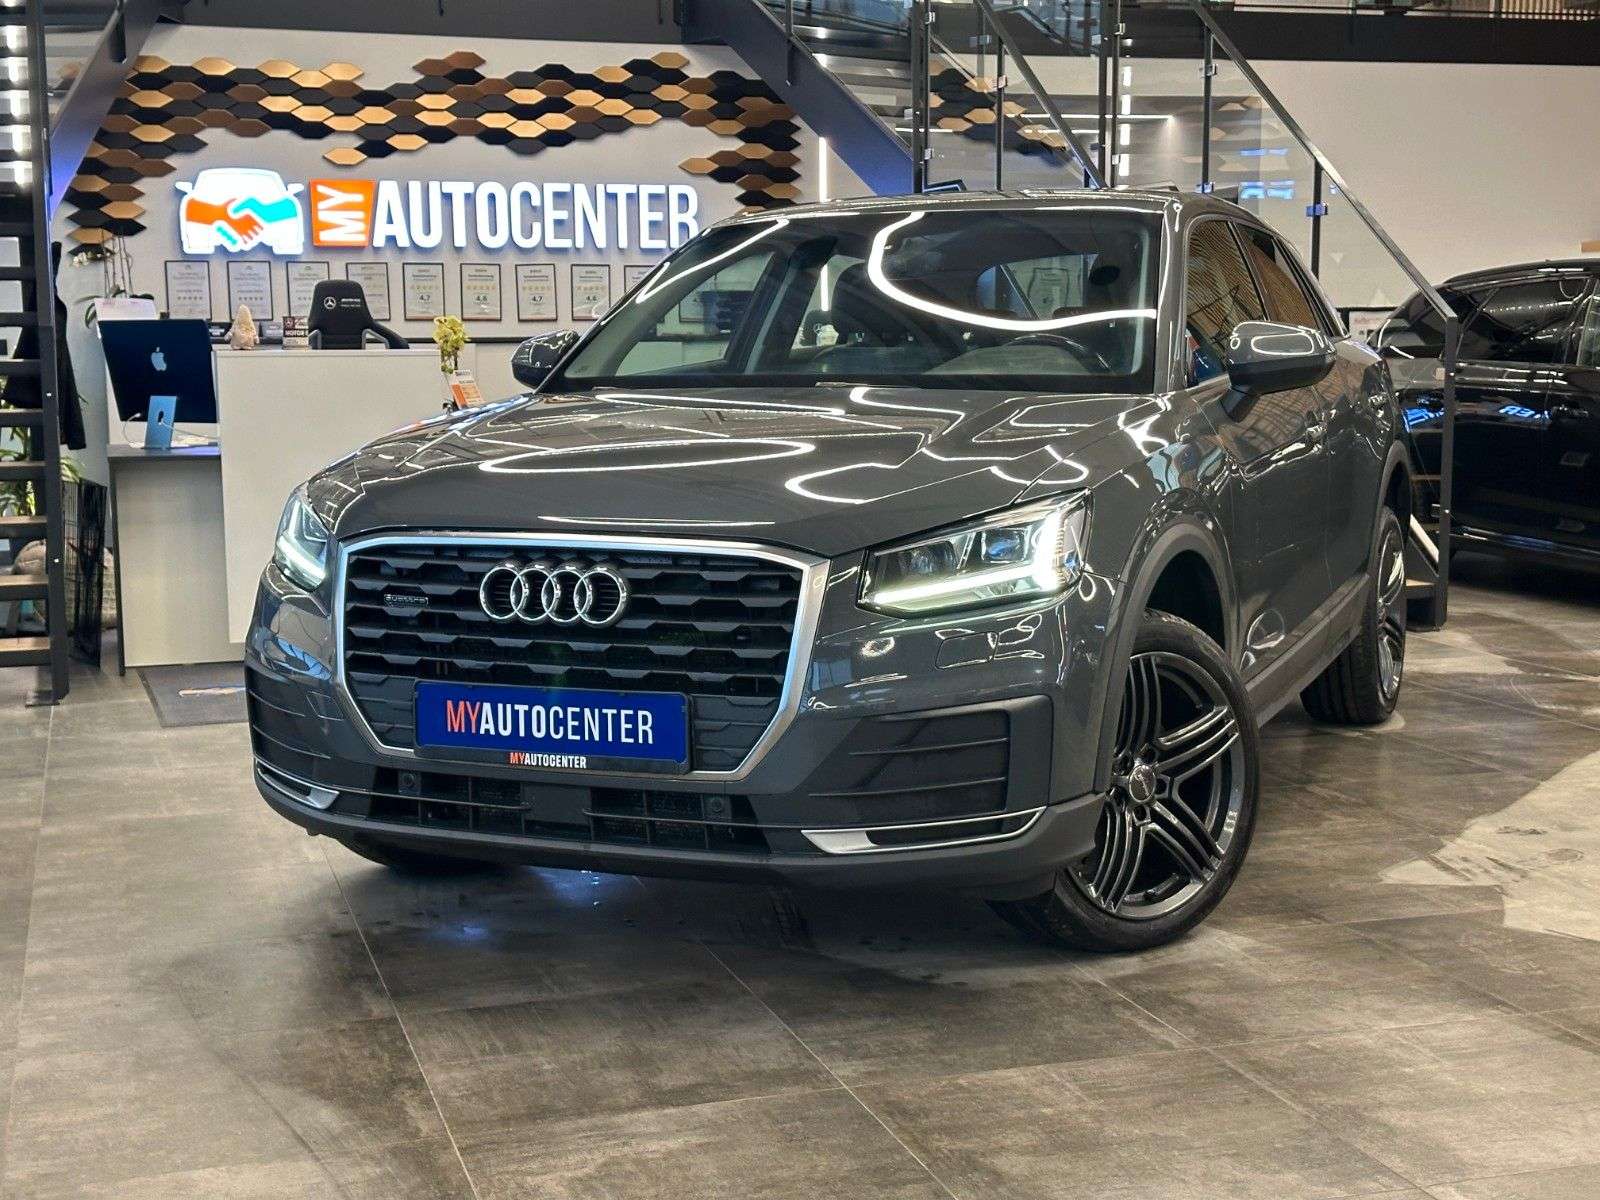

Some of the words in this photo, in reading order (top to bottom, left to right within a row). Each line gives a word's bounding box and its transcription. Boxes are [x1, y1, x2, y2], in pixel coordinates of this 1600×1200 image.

[316, 184, 366, 242] MY
[372, 181, 699, 248] AUTOCENTER
[446, 699, 654, 745] MYAUTOCENTER
[509, 751, 587, 769] MYAUTOCENTER
